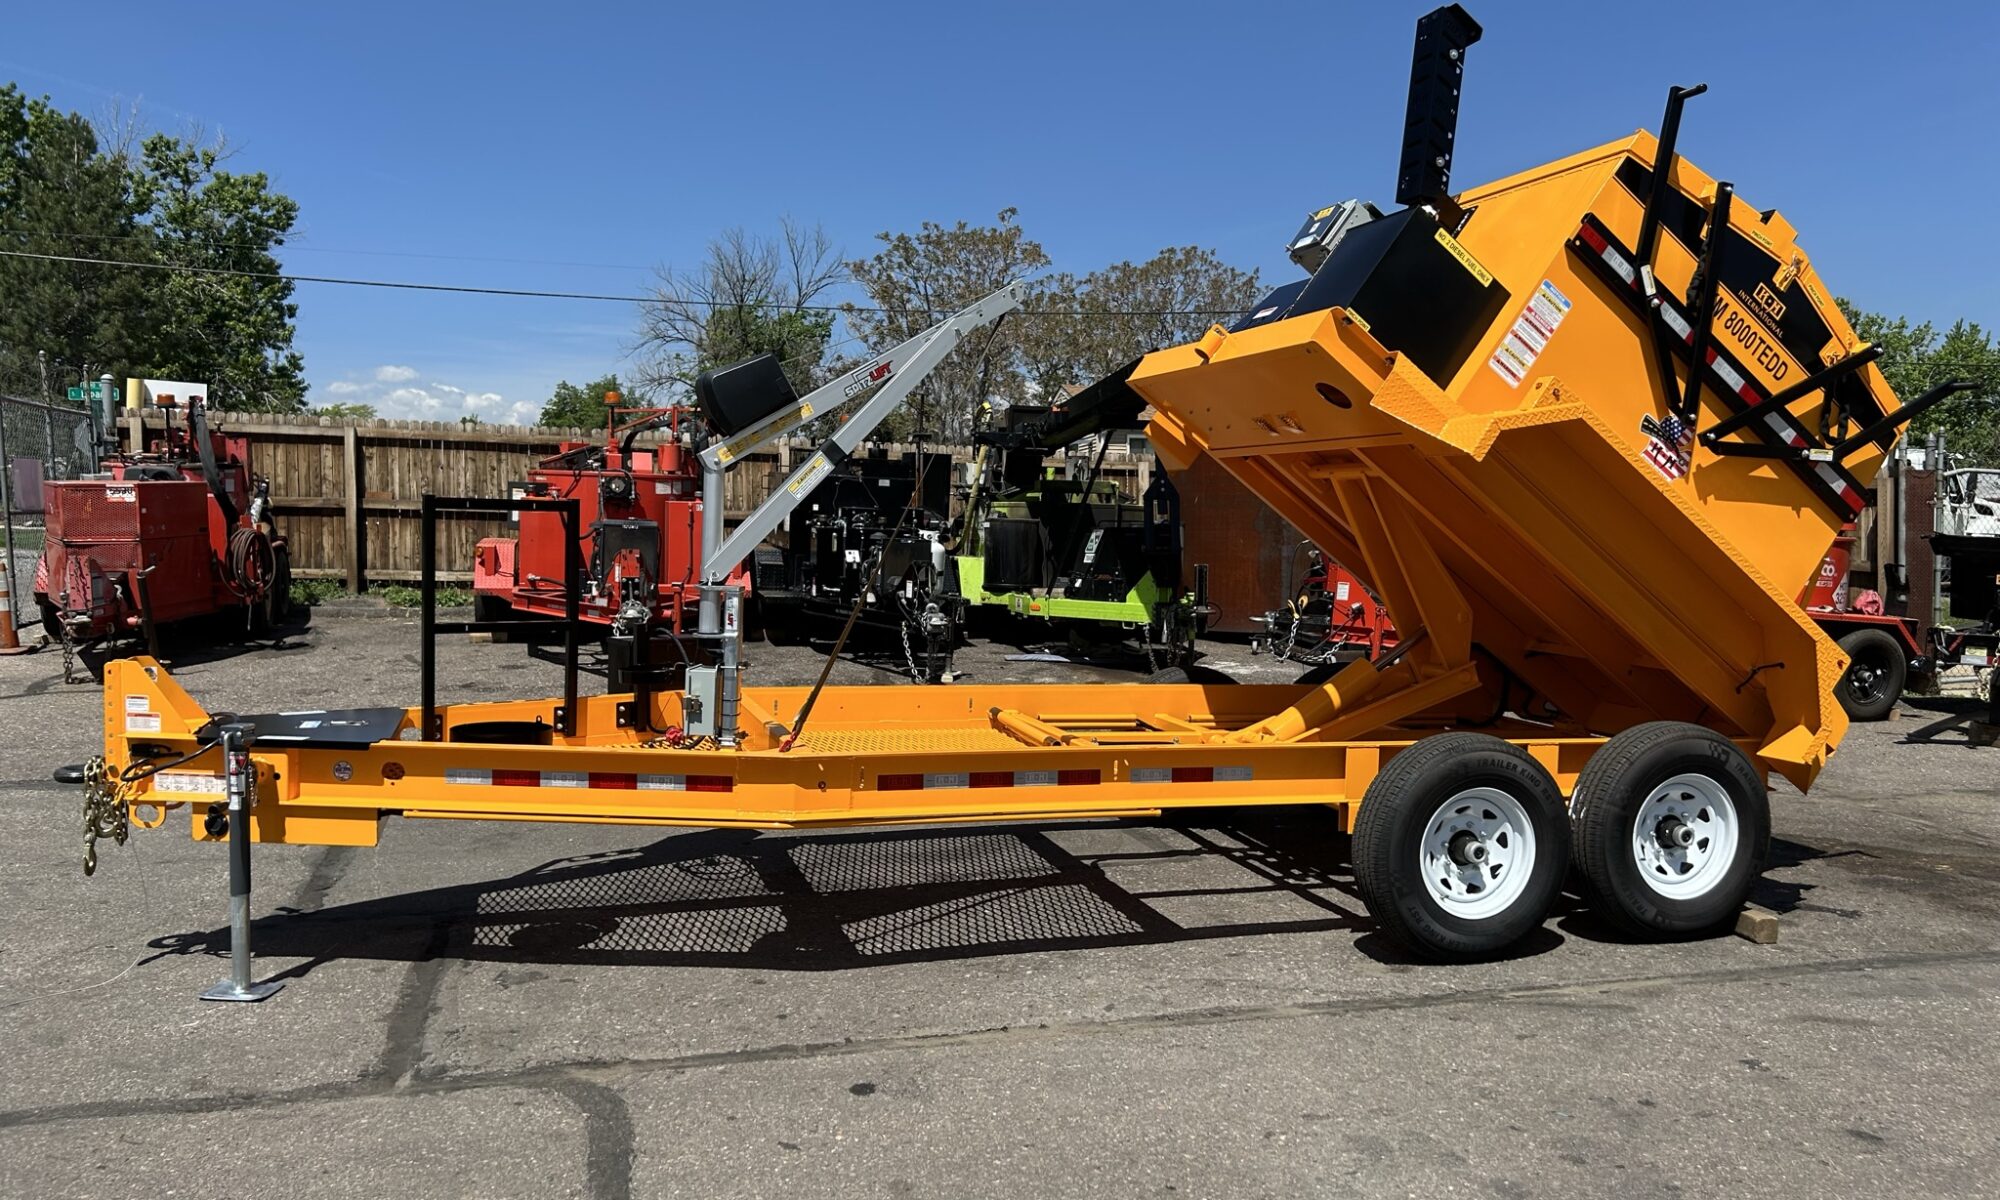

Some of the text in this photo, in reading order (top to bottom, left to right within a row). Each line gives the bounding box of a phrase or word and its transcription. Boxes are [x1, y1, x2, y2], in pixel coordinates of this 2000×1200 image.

[1449, 242, 1466, 261] DIESEL
[1465, 258, 1478, 272] FUEL
[1476, 269, 1490, 283] ONLY
[1545, 295, 1562, 313] CAUTION
[1738, 289, 1784, 339] INTERNATIONAL
[1508, 350, 1525, 367] CAUTION
[1724, 310, 1789, 381] 8000TEDD
[844, 361, 894, 398] SPITZLIFT
[799, 465, 817, 484] CAUTION
[1477, 758, 1519, 773] TRAILER
[1519, 767, 1542, 788] KING
